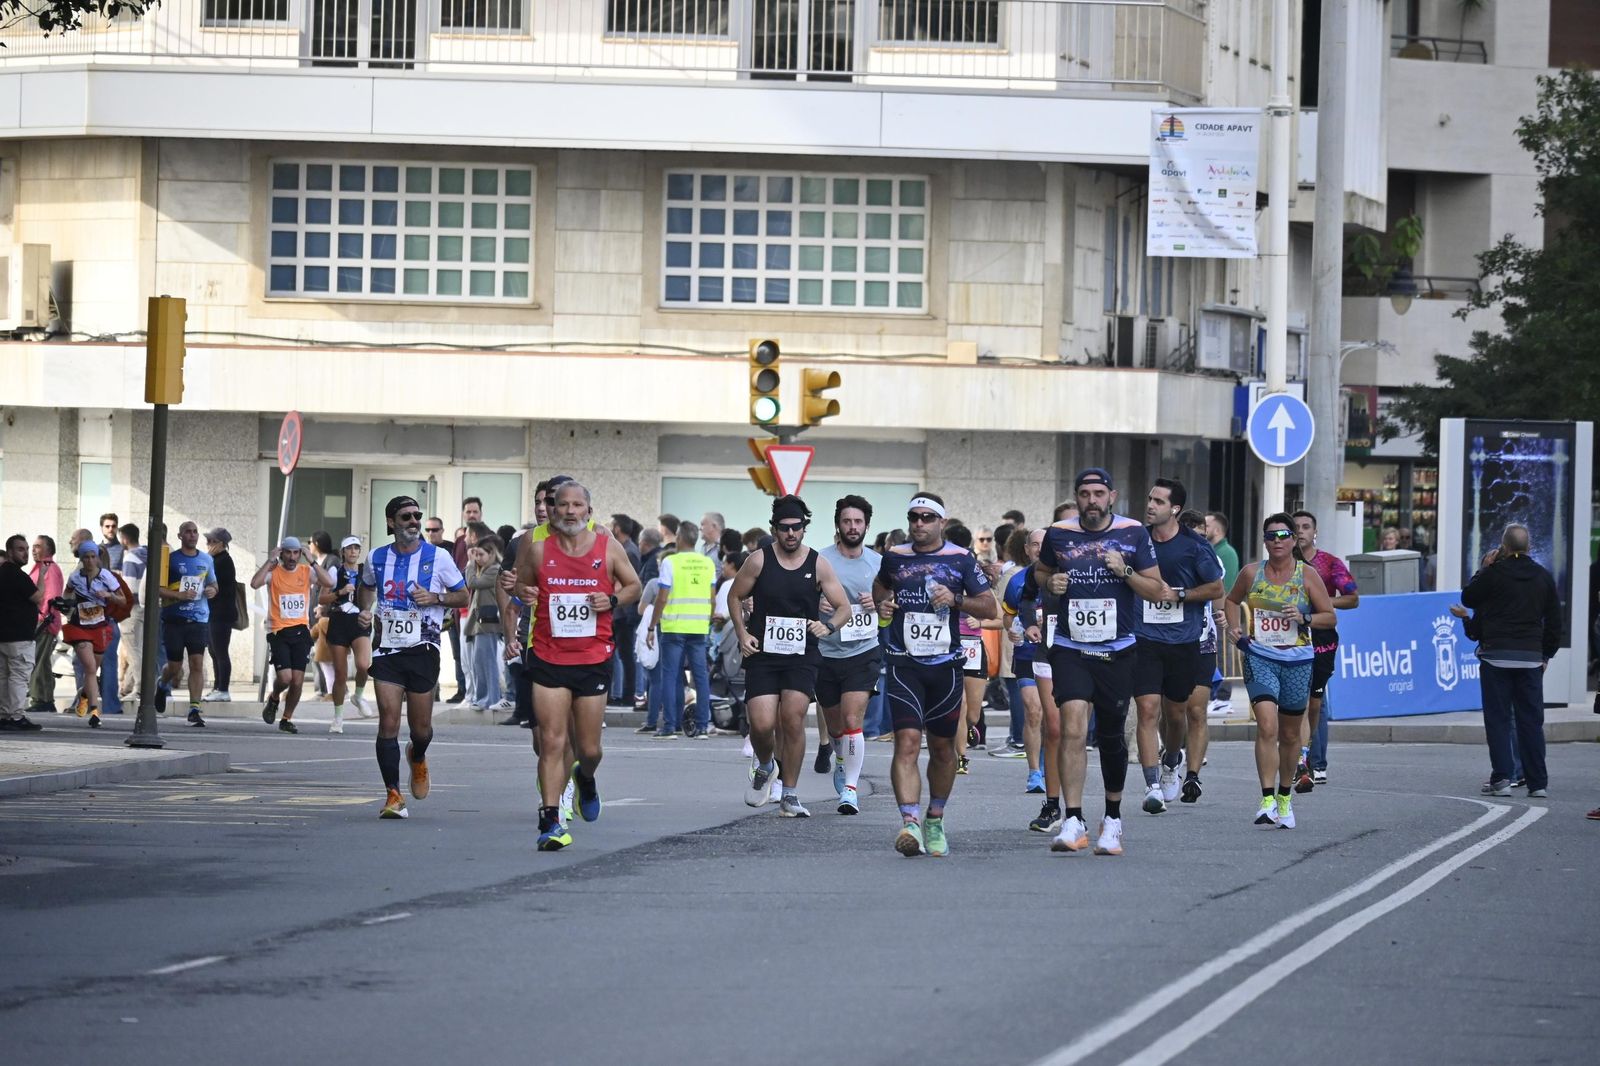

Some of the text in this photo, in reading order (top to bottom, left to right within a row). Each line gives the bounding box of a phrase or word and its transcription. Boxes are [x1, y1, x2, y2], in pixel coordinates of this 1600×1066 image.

[1195, 122, 1252, 133] CIDADE APAVT
[547, 577, 598, 587] SAN PEDRO
[281, 600, 304, 610] 1095
[557, 605, 590, 621] 849
[1075, 610, 1107, 626] 961
[387, 620, 413, 634] 750
[1261, 618, 1290, 631] 809
[767, 626, 804, 641] 1063
[910, 624, 943, 641] 947
[1340, 641, 1413, 679] Huelva
[1388, 679, 1414, 694] original
